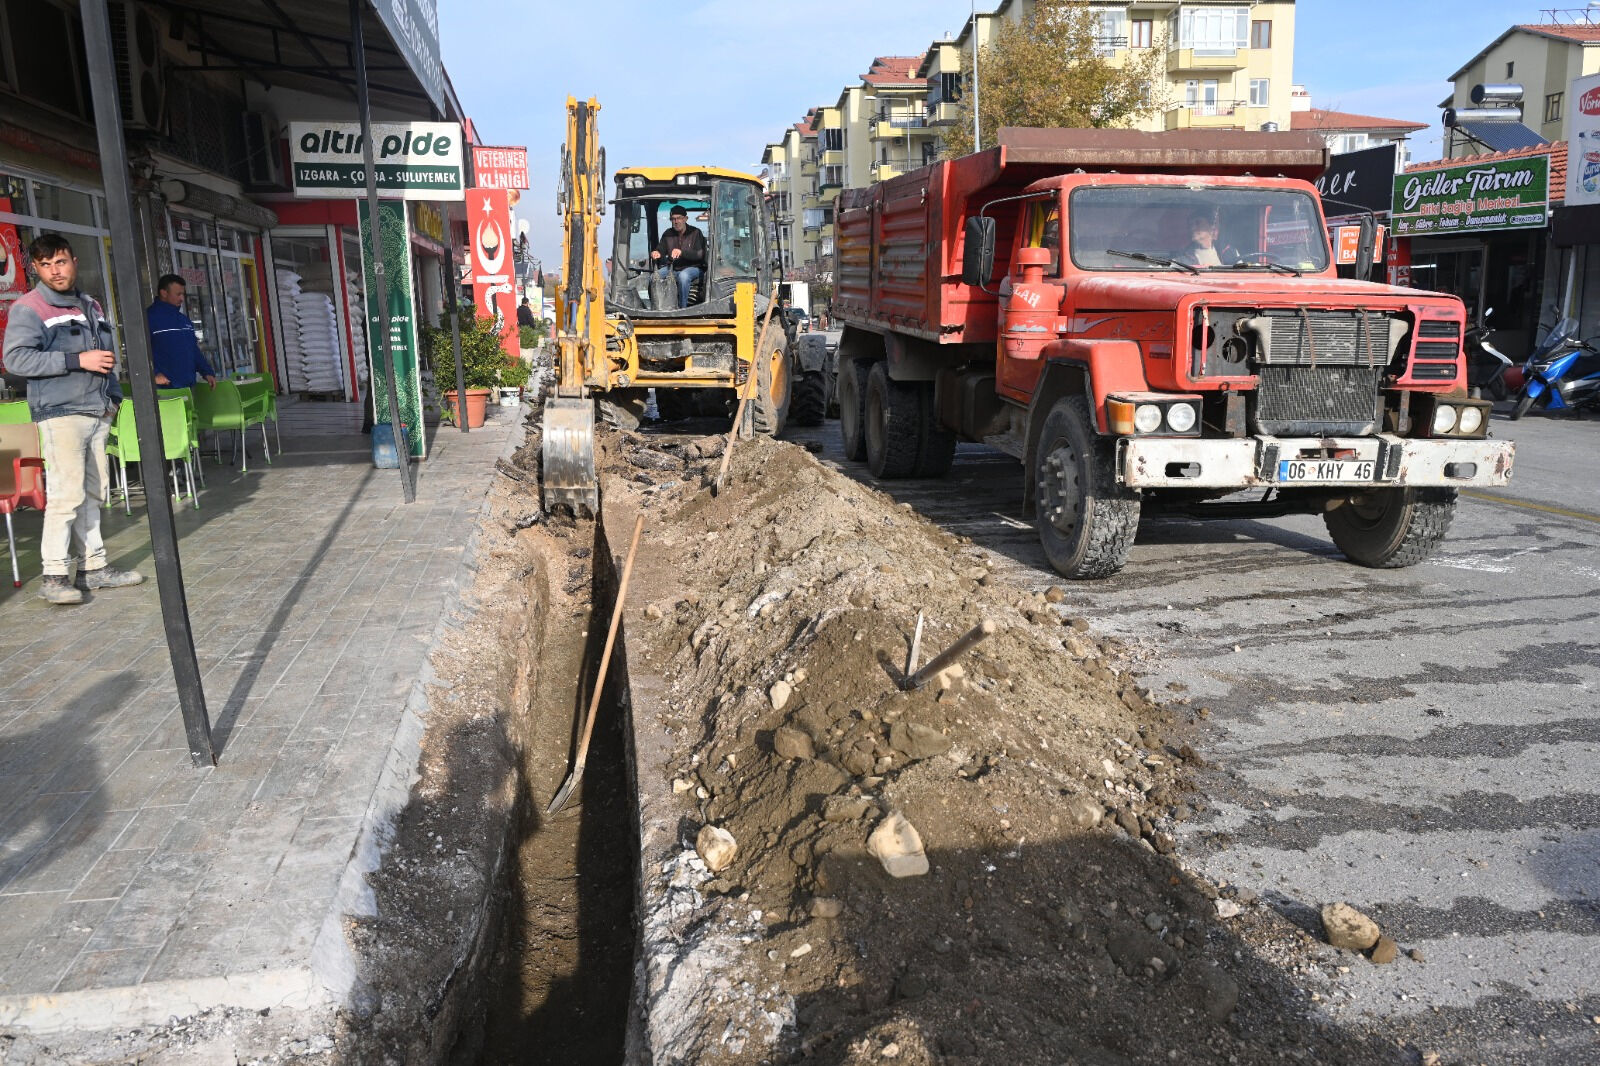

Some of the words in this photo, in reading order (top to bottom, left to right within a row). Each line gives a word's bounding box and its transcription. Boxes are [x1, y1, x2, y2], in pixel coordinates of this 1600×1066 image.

[396, 171, 457, 183] SULUYEMEK
[478, 169, 527, 189] KLİNİĞİ
[1403, 172, 1464, 210] Göller
[1466, 167, 1535, 199] Tarım
[1419, 202, 1440, 215] Bitki
[1441, 199, 1476, 214] Sağlığı
[1478, 194, 1521, 211] Merkezi
[1288, 463, 1306, 479] 06
[1316, 463, 1344, 479] KHY
[1354, 463, 1371, 479] 46
